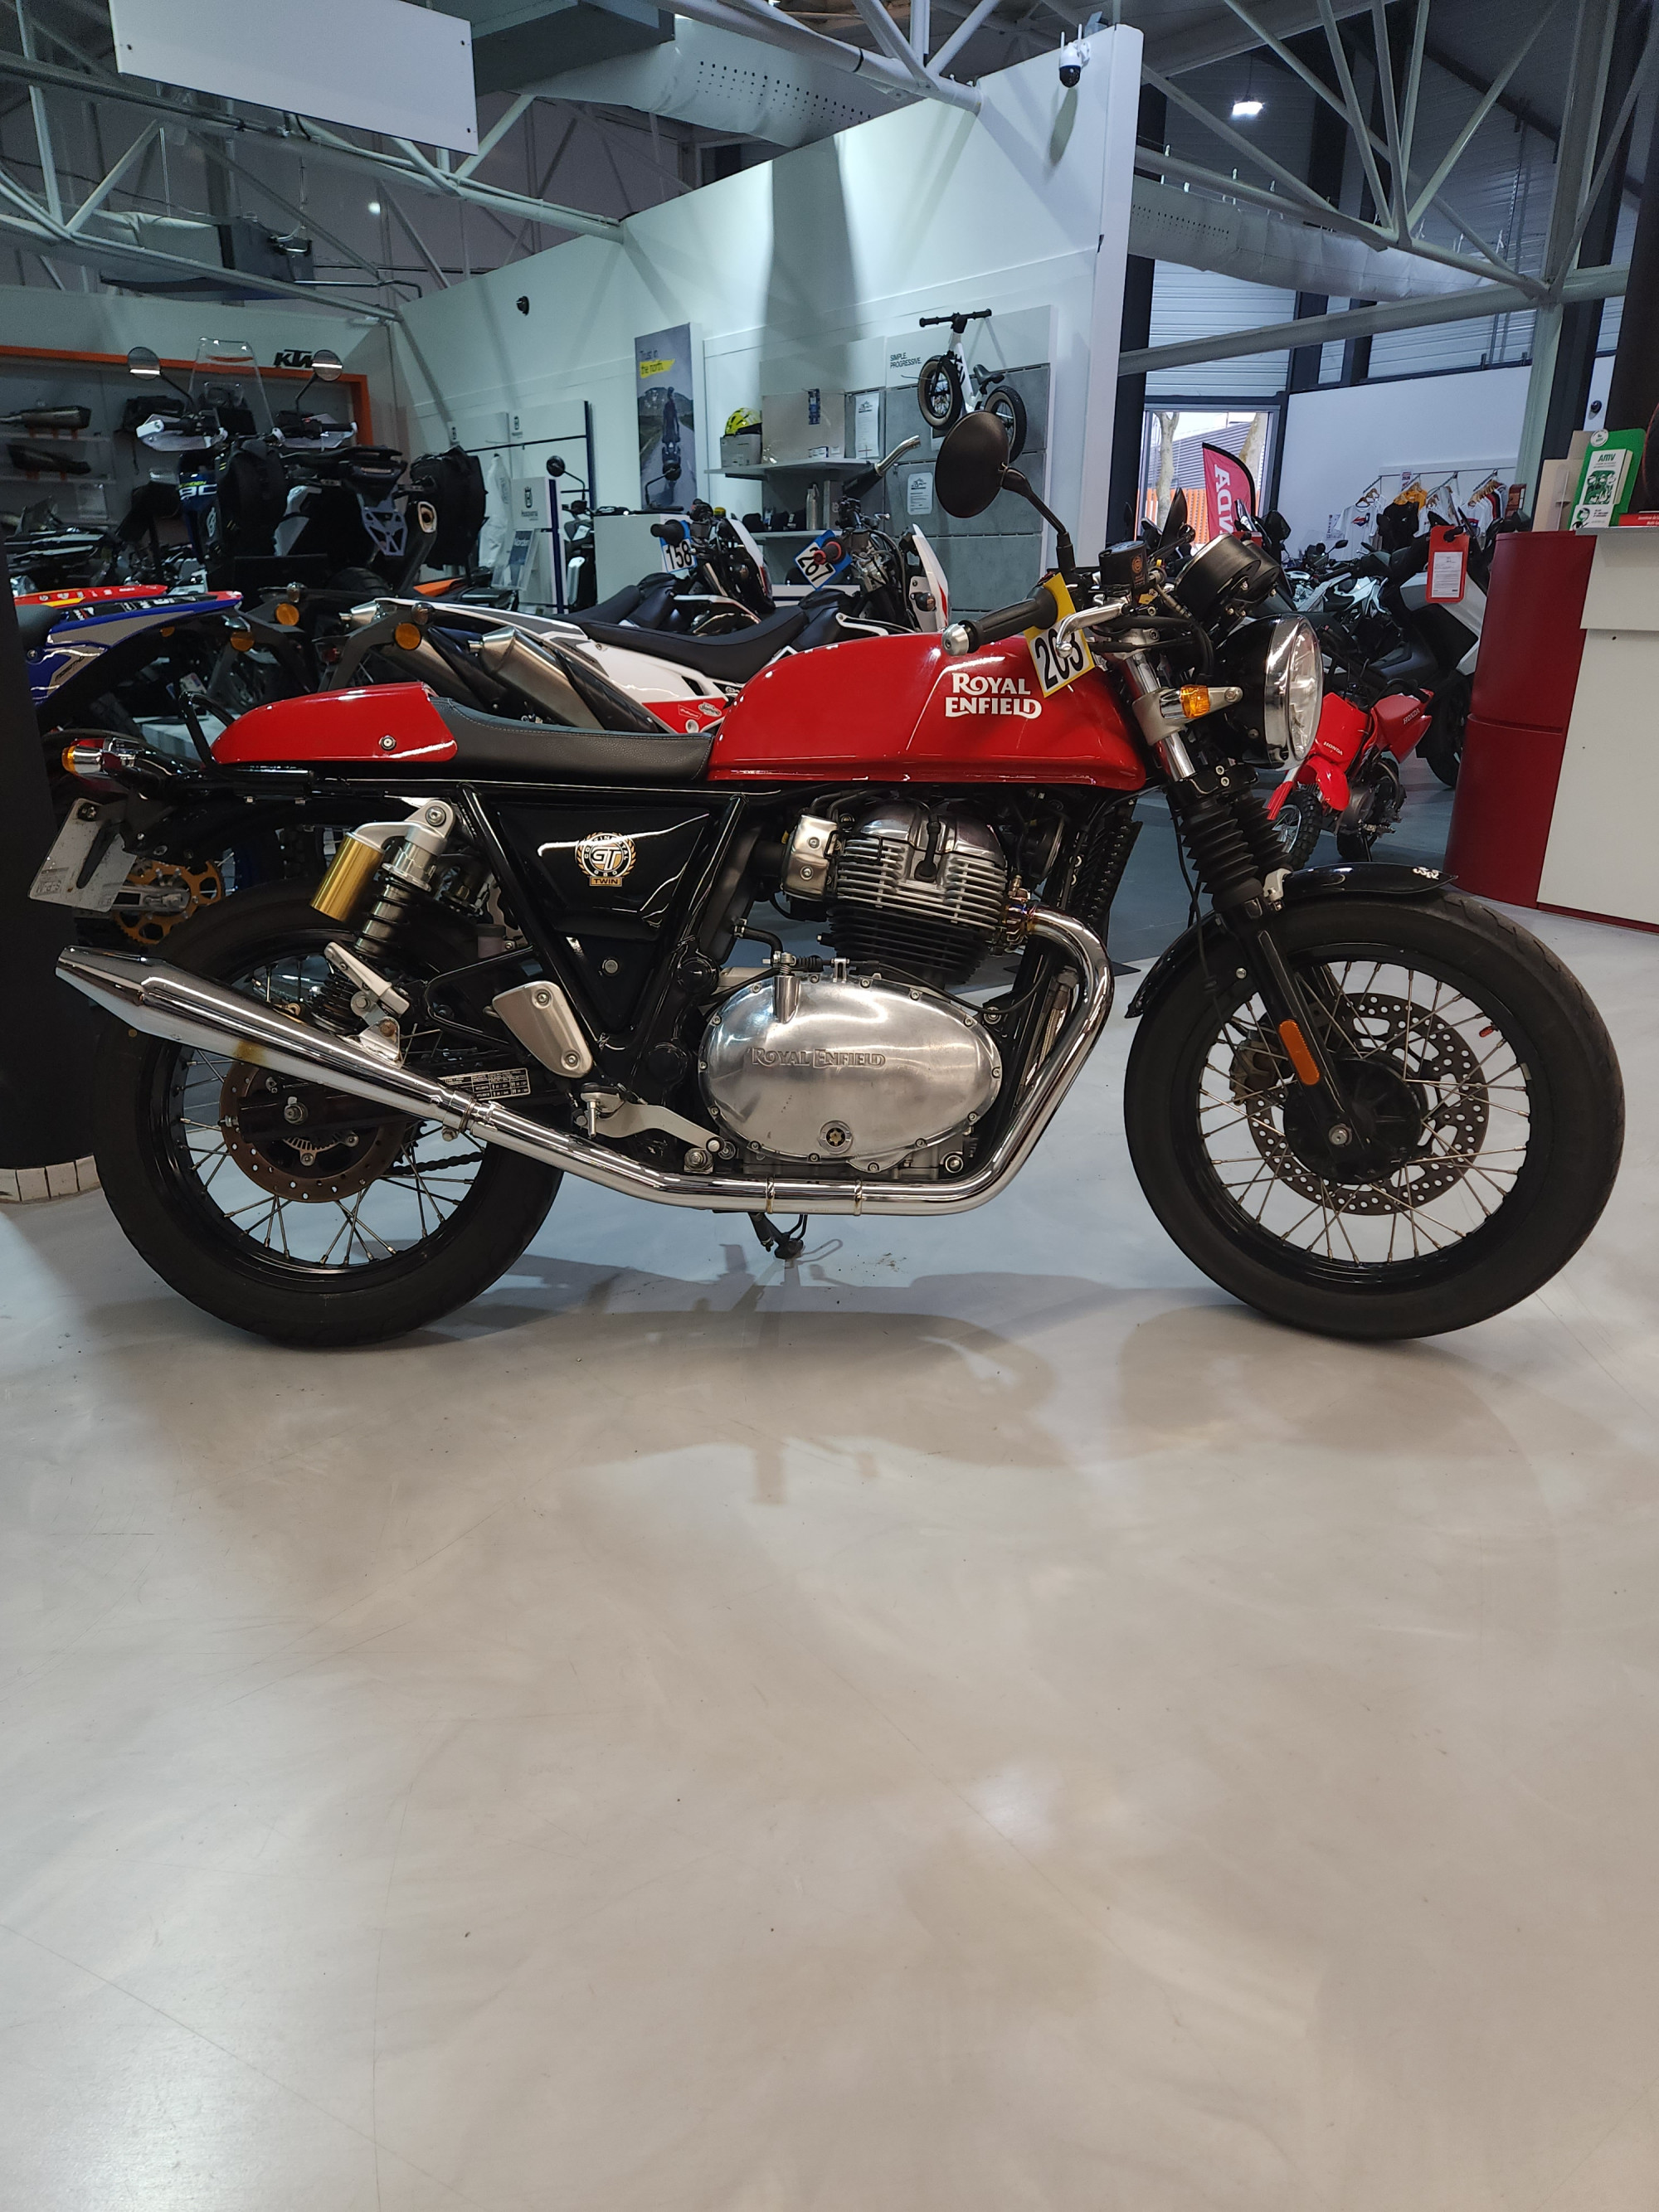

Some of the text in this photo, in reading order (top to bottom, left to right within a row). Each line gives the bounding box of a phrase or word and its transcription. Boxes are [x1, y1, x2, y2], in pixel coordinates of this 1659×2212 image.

[1598, 453, 1617, 462] AMV
[665, 540, 693, 569] 158
[951, 673, 1031, 696] ROYAL
[945, 697, 1042, 719] ENFIELD
[1403, 708, 1420, 725] HONDA
[1323, 741, 1343, 756] HONDA
[591, 846, 623, 871] GT
[752, 1048, 886, 1069] ROYAL ENFIELD
